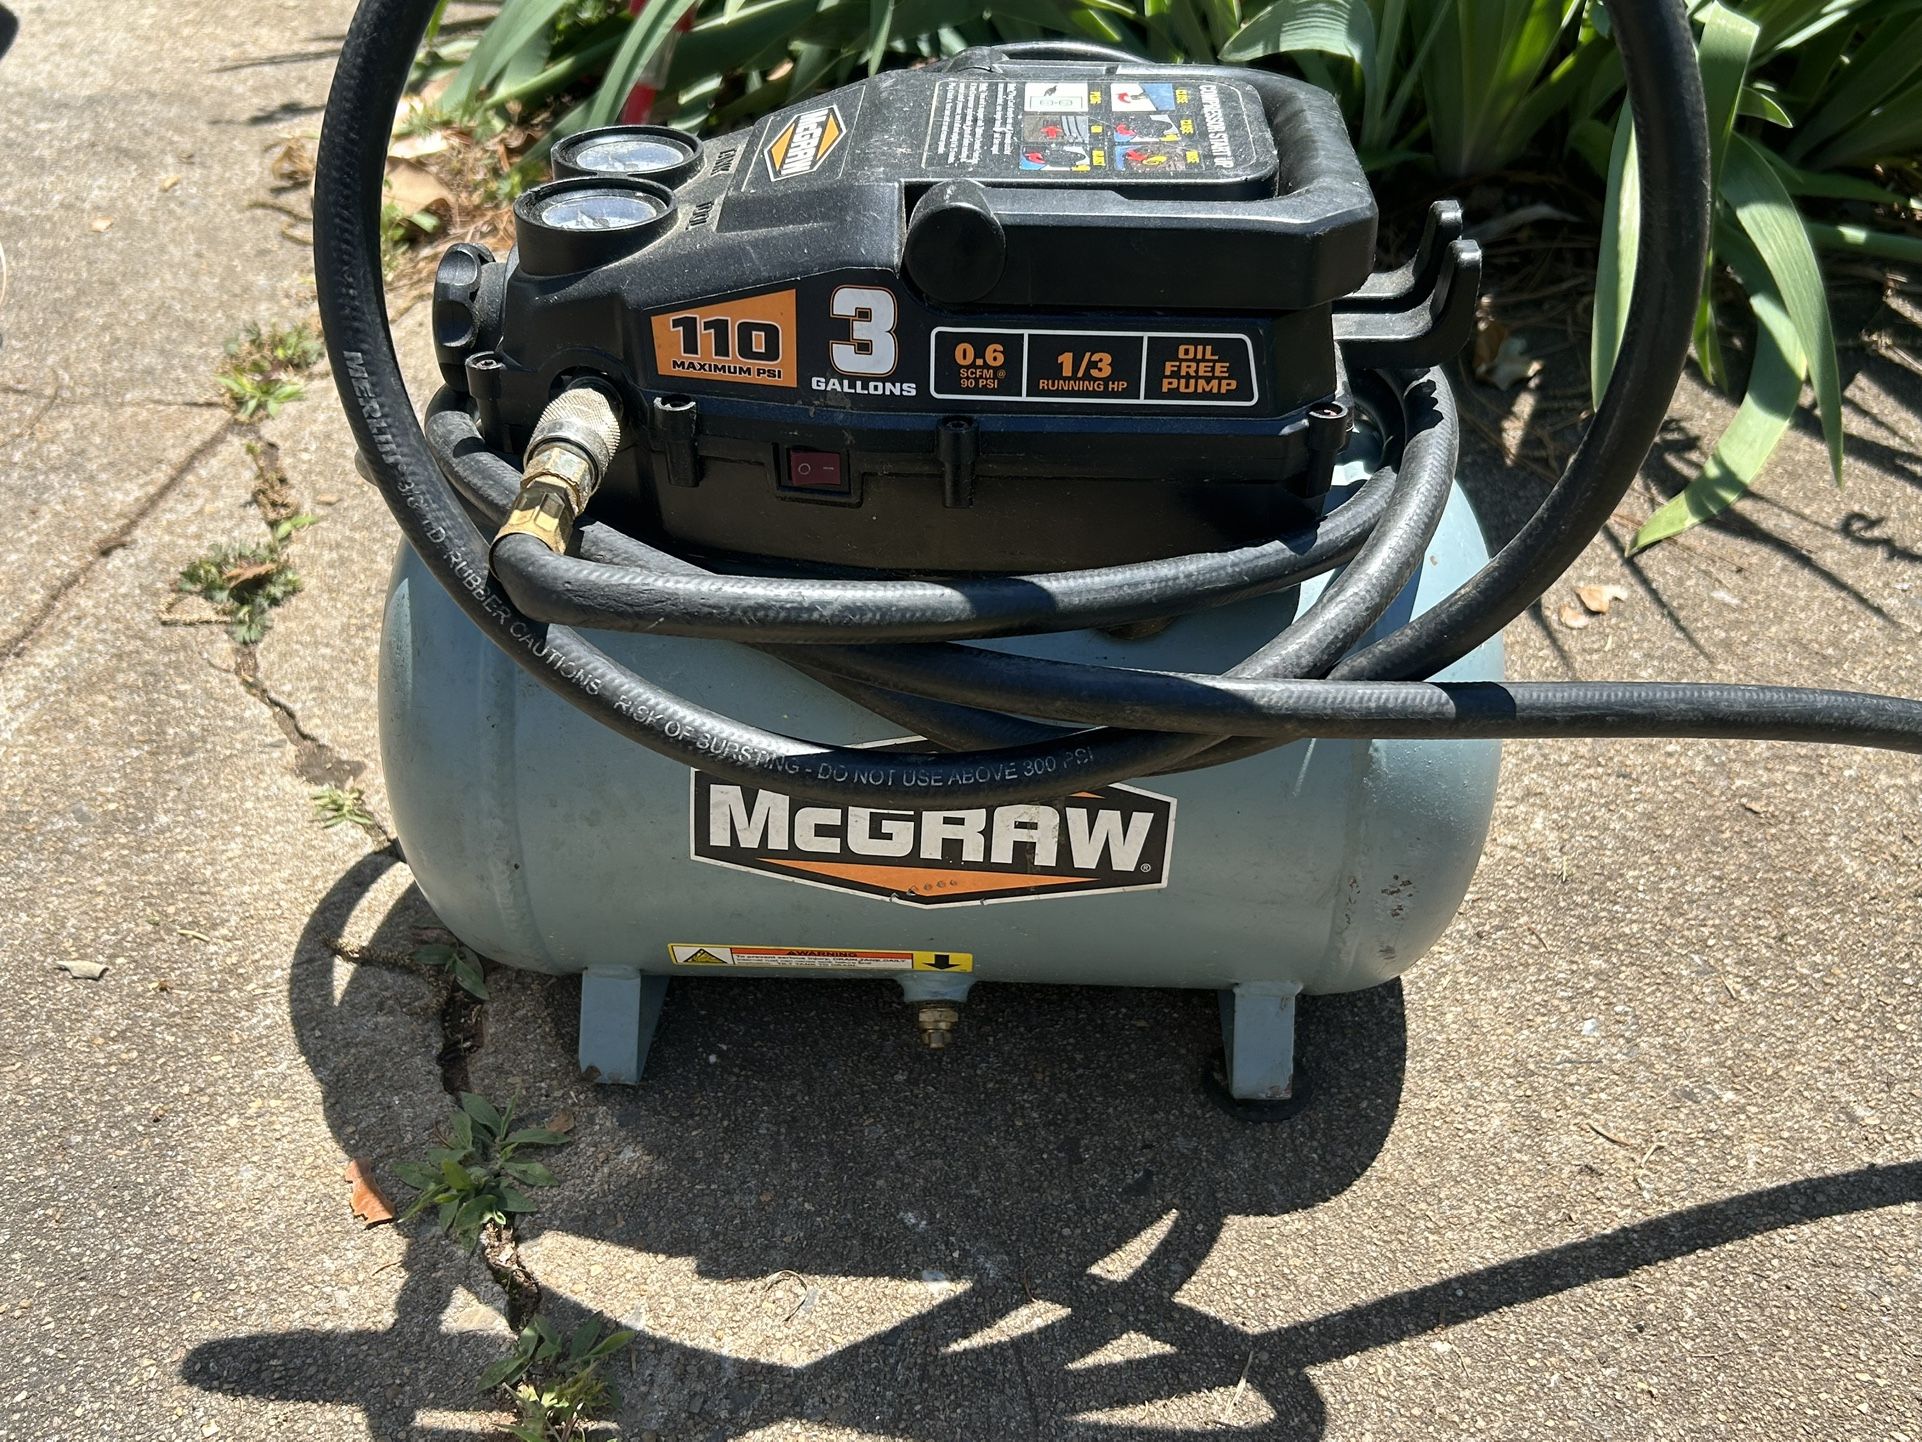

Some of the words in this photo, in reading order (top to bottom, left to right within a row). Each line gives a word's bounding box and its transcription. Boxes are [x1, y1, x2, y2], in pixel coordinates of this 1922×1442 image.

[1199, 84, 1226, 133] COMPRESSOR
[779, 109, 830, 176] McGRAW
[1208, 132, 1233, 160] START
[710, 148, 737, 177] TANK
[1213, 158, 1235, 169] UP
[669, 314, 782, 364] 110
[828, 284, 899, 377] 3
[954, 342, 1005, 367] 0.6
[1177, 344, 1219, 360] OIL
[671, 359, 752, 377] MAXIMUM
[756, 366, 782, 380] PSI
[959, 368, 994, 379] SCFM
[1056, 351, 1113, 378] 1/3
[1164, 361, 1230, 377] FREE
[811, 377, 917, 396] GALLONS
[960, 378, 976, 389] 90
[978, 378, 998, 389] PSI
[1039, 379, 1104, 392] RUNNING
[1108, 380, 1128, 392] HP
[1161, 378, 1237, 394] PUMP
[443, 550, 512, 625] RUBBER
[614, 695, 664, 726] RISK
[664, 720, 694, 741] OF
[696, 733, 800, 774] BURSTING
[818, 763, 848, 782] DO
[853, 768, 896, 786] NOT
[902, 768, 943, 787] USE
[948, 762, 1018, 785] ABOVE
[1023, 756, 1056, 777] 300
[1063, 747, 1094, 769] PSI
